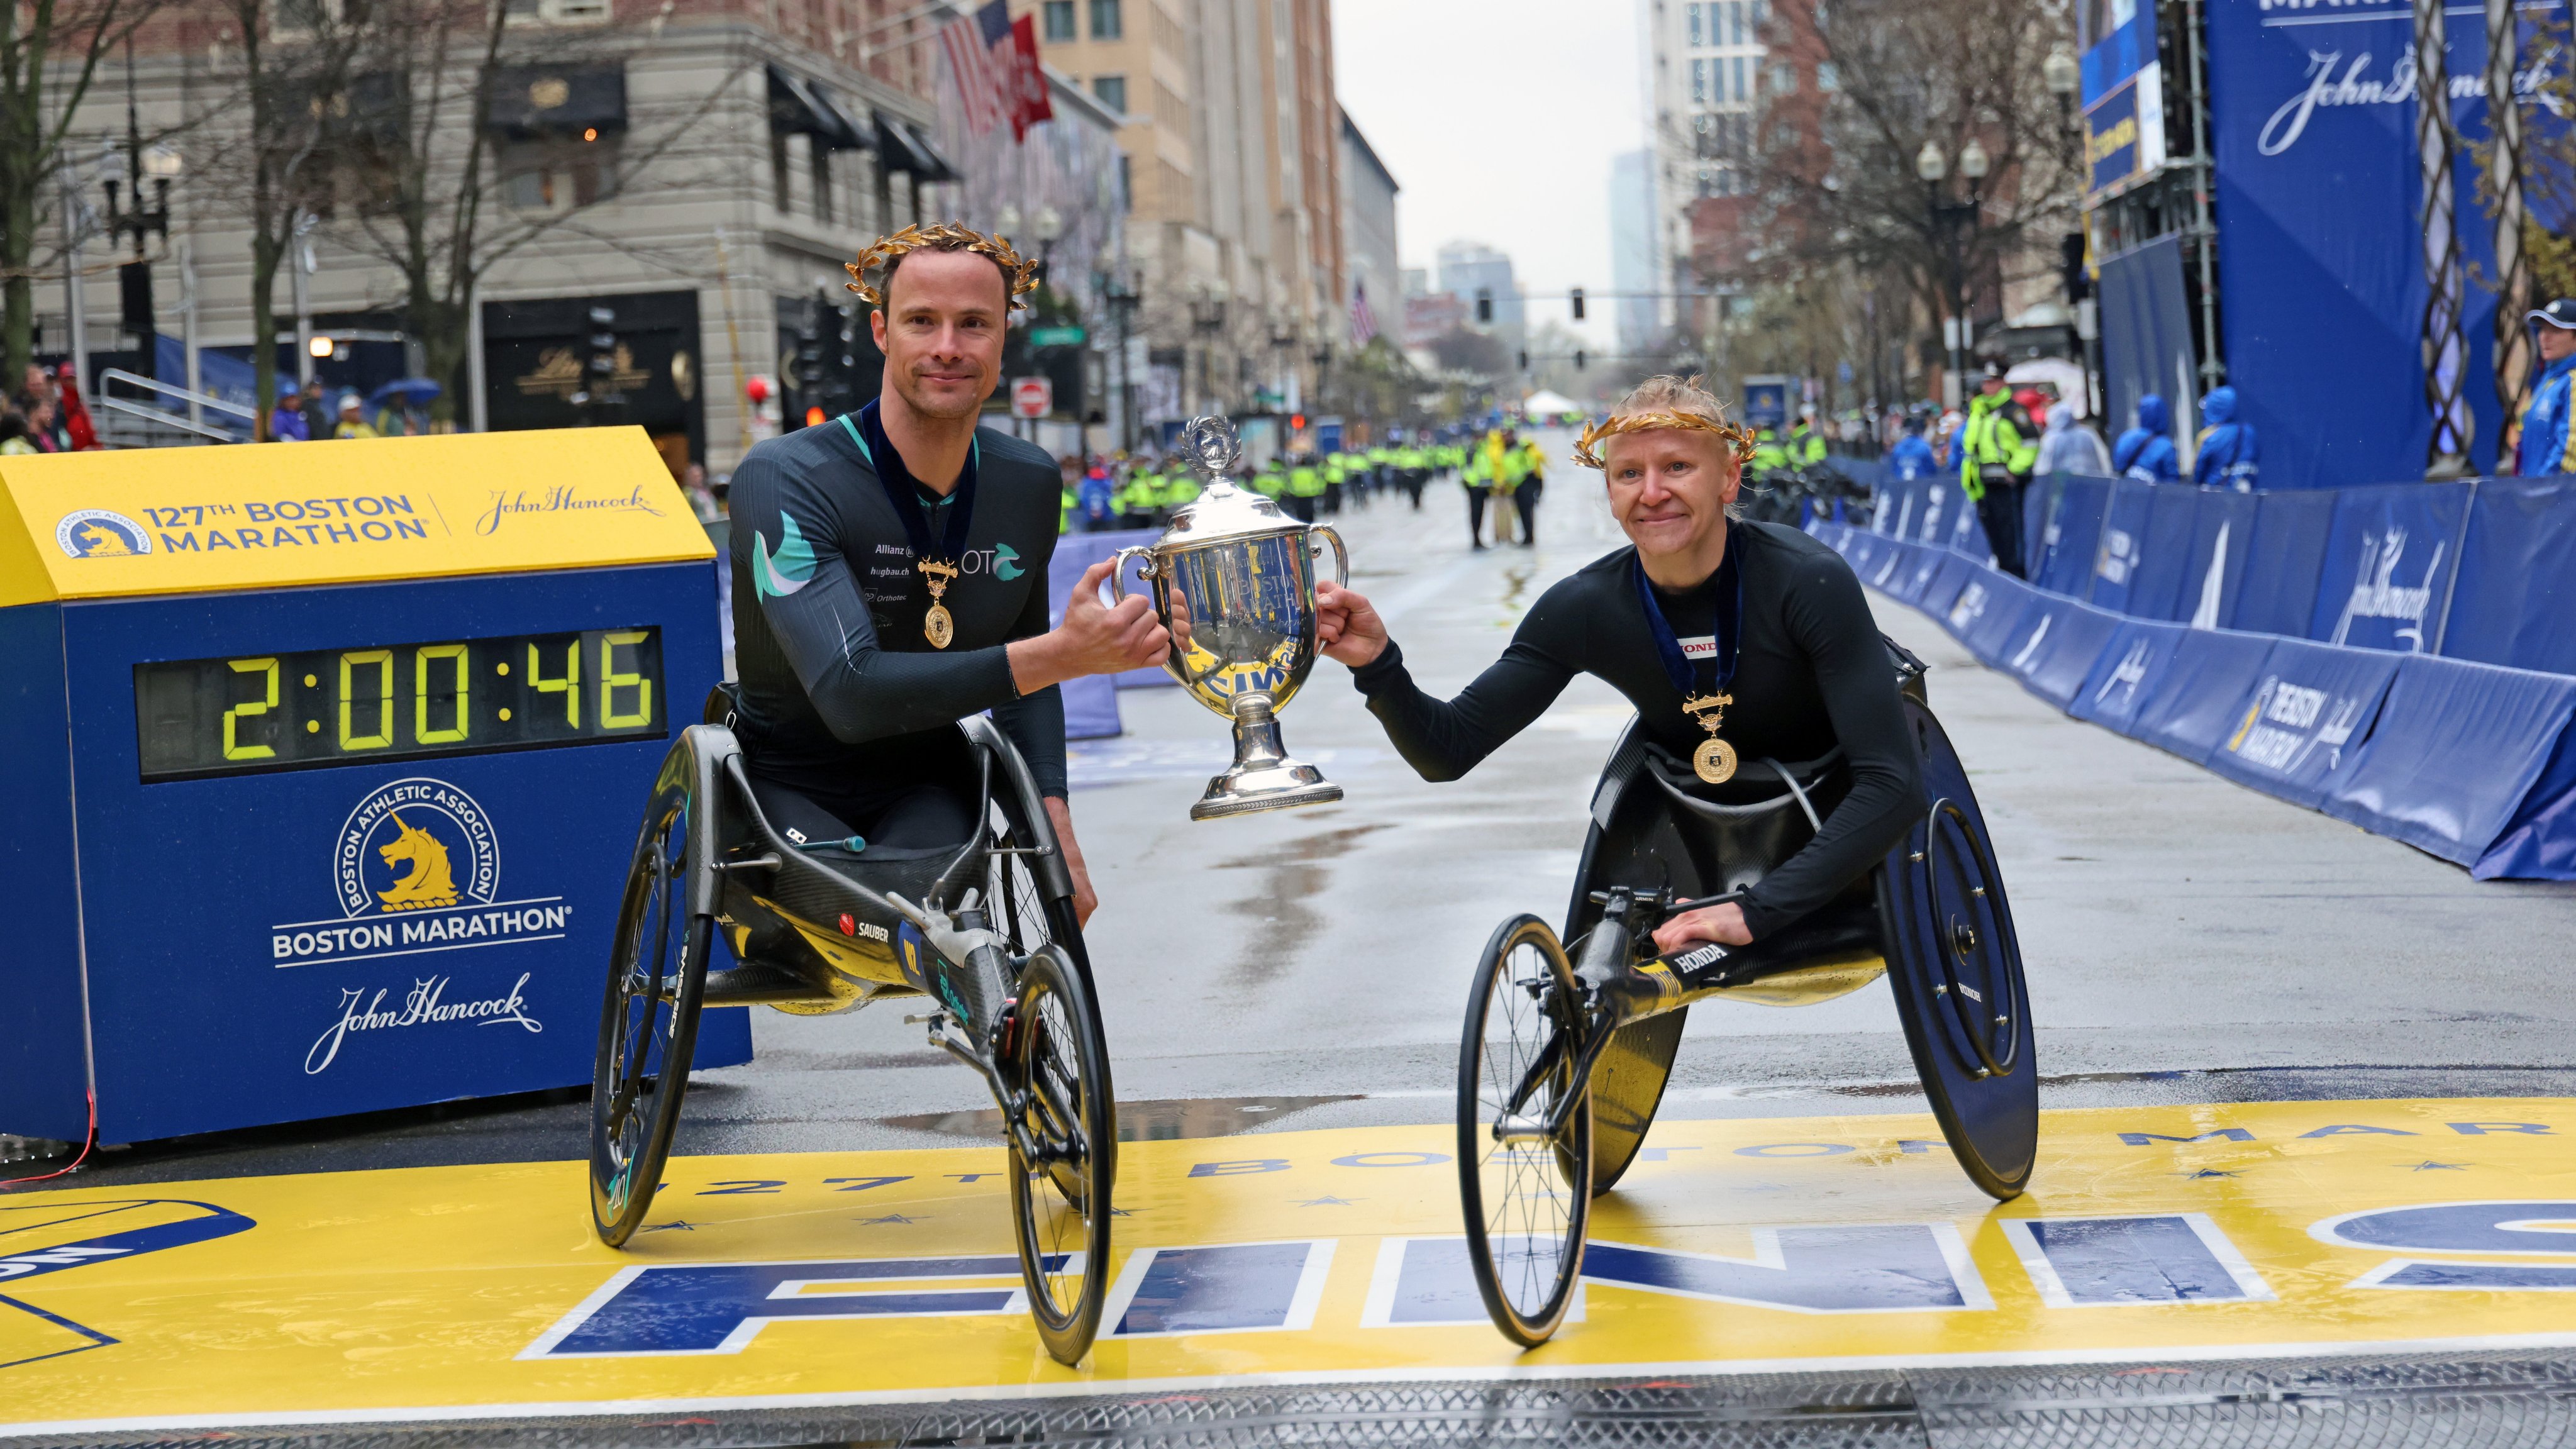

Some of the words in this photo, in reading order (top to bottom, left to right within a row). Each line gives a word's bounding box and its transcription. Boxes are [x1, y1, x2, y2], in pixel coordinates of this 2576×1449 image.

[64, 511, 102, 527] ATHLETIC
[142, 504, 236, 529] 127TH
[244, 494, 415, 523] BOSTON
[475, 489, 541, 536] John
[542, 484, 667, 518] Hancock
[60, 528, 77, 555] BOSTON
[104, 512, 148, 551] ASSOCIATION
[875, 544, 904, 555] Allianz
[961, 550, 996, 574] OT
[870, 567, 909, 577] hugbau.ch
[1680, 642, 1717, 653] OND
[222, 631, 652, 760] 2:00:46
[342, 830, 363, 908] BOSTON
[357, 785, 432, 831] ATHLETIC
[433, 789, 493, 895] ASSOCIATION
[272, 924, 393, 958] BOSTON
[858, 922, 889, 943] SAUBER
[677, 945, 688, 999] SWISS
[1674, 943, 1729, 974] HONDA
[1957, 982, 1982, 1002] HONDA
[305, 987, 399, 1075] John
[396, 972, 543, 1033] Hancock
[669, 1000, 680, 1039] SIDE
